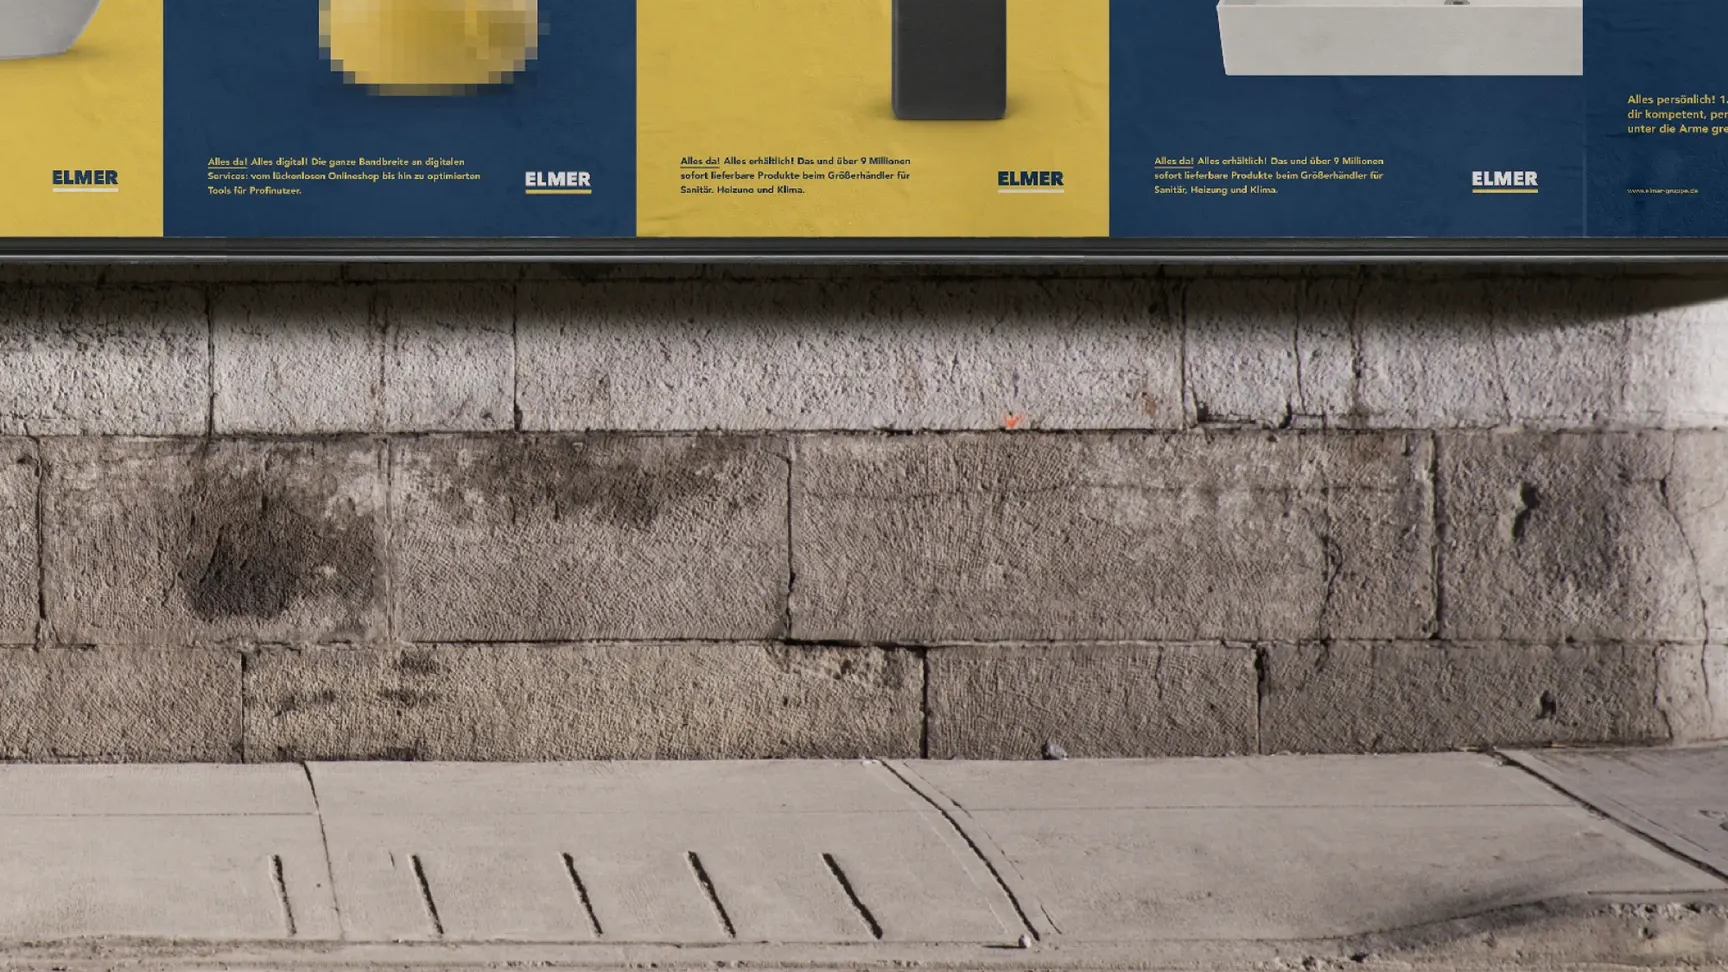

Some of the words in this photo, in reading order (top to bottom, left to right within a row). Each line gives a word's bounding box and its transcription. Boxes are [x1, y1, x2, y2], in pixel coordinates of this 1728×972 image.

[1628, 94, 1654, 104] Alles
[1656, 94, 1715, 106] persönlich!
[1628, 108, 1642, 118] dir
[1645, 109, 1706, 122] kompetent,
[1628, 125, 1656, 133] unter
[1659, 124, 1676, 133] die
[1679, 124, 1709, 133] Arme
[208, 157, 230, 166] Alles
[251, 157, 273, 165] Alles
[276, 157, 308, 168] digital!
[312, 157, 326, 165] Die
[329, 160, 356, 168] ganze
[358, 157, 409, 166] Bandbreite
[425, 157, 464, 168] digitalen
[681, 156, 703, 164] Alles
[724, 156, 746, 164] Alles
[749, 156, 795, 165] erhältlich!
[797, 157, 814, 165] Das
[816, 157, 835, 165] und
[1155, 156, 1177, 164] Alles
[1197, 156, 1220, 165] Alles
[1222, 156, 1266, 164] erhältlich!
[1270, 156, 1288, 165] Das
[1309, 156, 1331, 165] über
[1342, 156, 1384, 164] Millionen
[53, 170, 119, 185] ELMER
[208, 172, 248, 180] Services:
[273, 171, 327, 180] lückenlosen
[328, 172, 379, 182] Onlineshop
[381, 172, 395, 180] bis
[427, 172, 480, 182] optimierten
[525, 171, 592, 186] ELMER
[681, 171, 708, 179] sofort
[711, 171, 754, 179] lieferbare
[757, 171, 800, 179] Produkte
[802, 171, 825, 179] beim
[827, 171, 894, 179] Größerhändler
[897, 171, 910, 179] für
[998, 170, 1064, 186] ELMER
[1155, 171, 1182, 179] sofort
[1184, 171, 1228, 179] lieferbare
[1231, 171, 1273, 180] Produkte
[1275, 171, 1298, 179] beim
[1300, 171, 1368, 180] Größerhändler
[1370, 171, 1384, 180] für
[1472, 171, 1539, 186] ELMER
[208, 185, 232, 194] Tools
[233, 186, 246, 195] für
[249, 185, 301, 195] Profinutzer.
[1190, 186, 1229, 196] Heizung
[1230, 185, 1248, 194] und
[1250, 185, 1278, 194] Klima.
